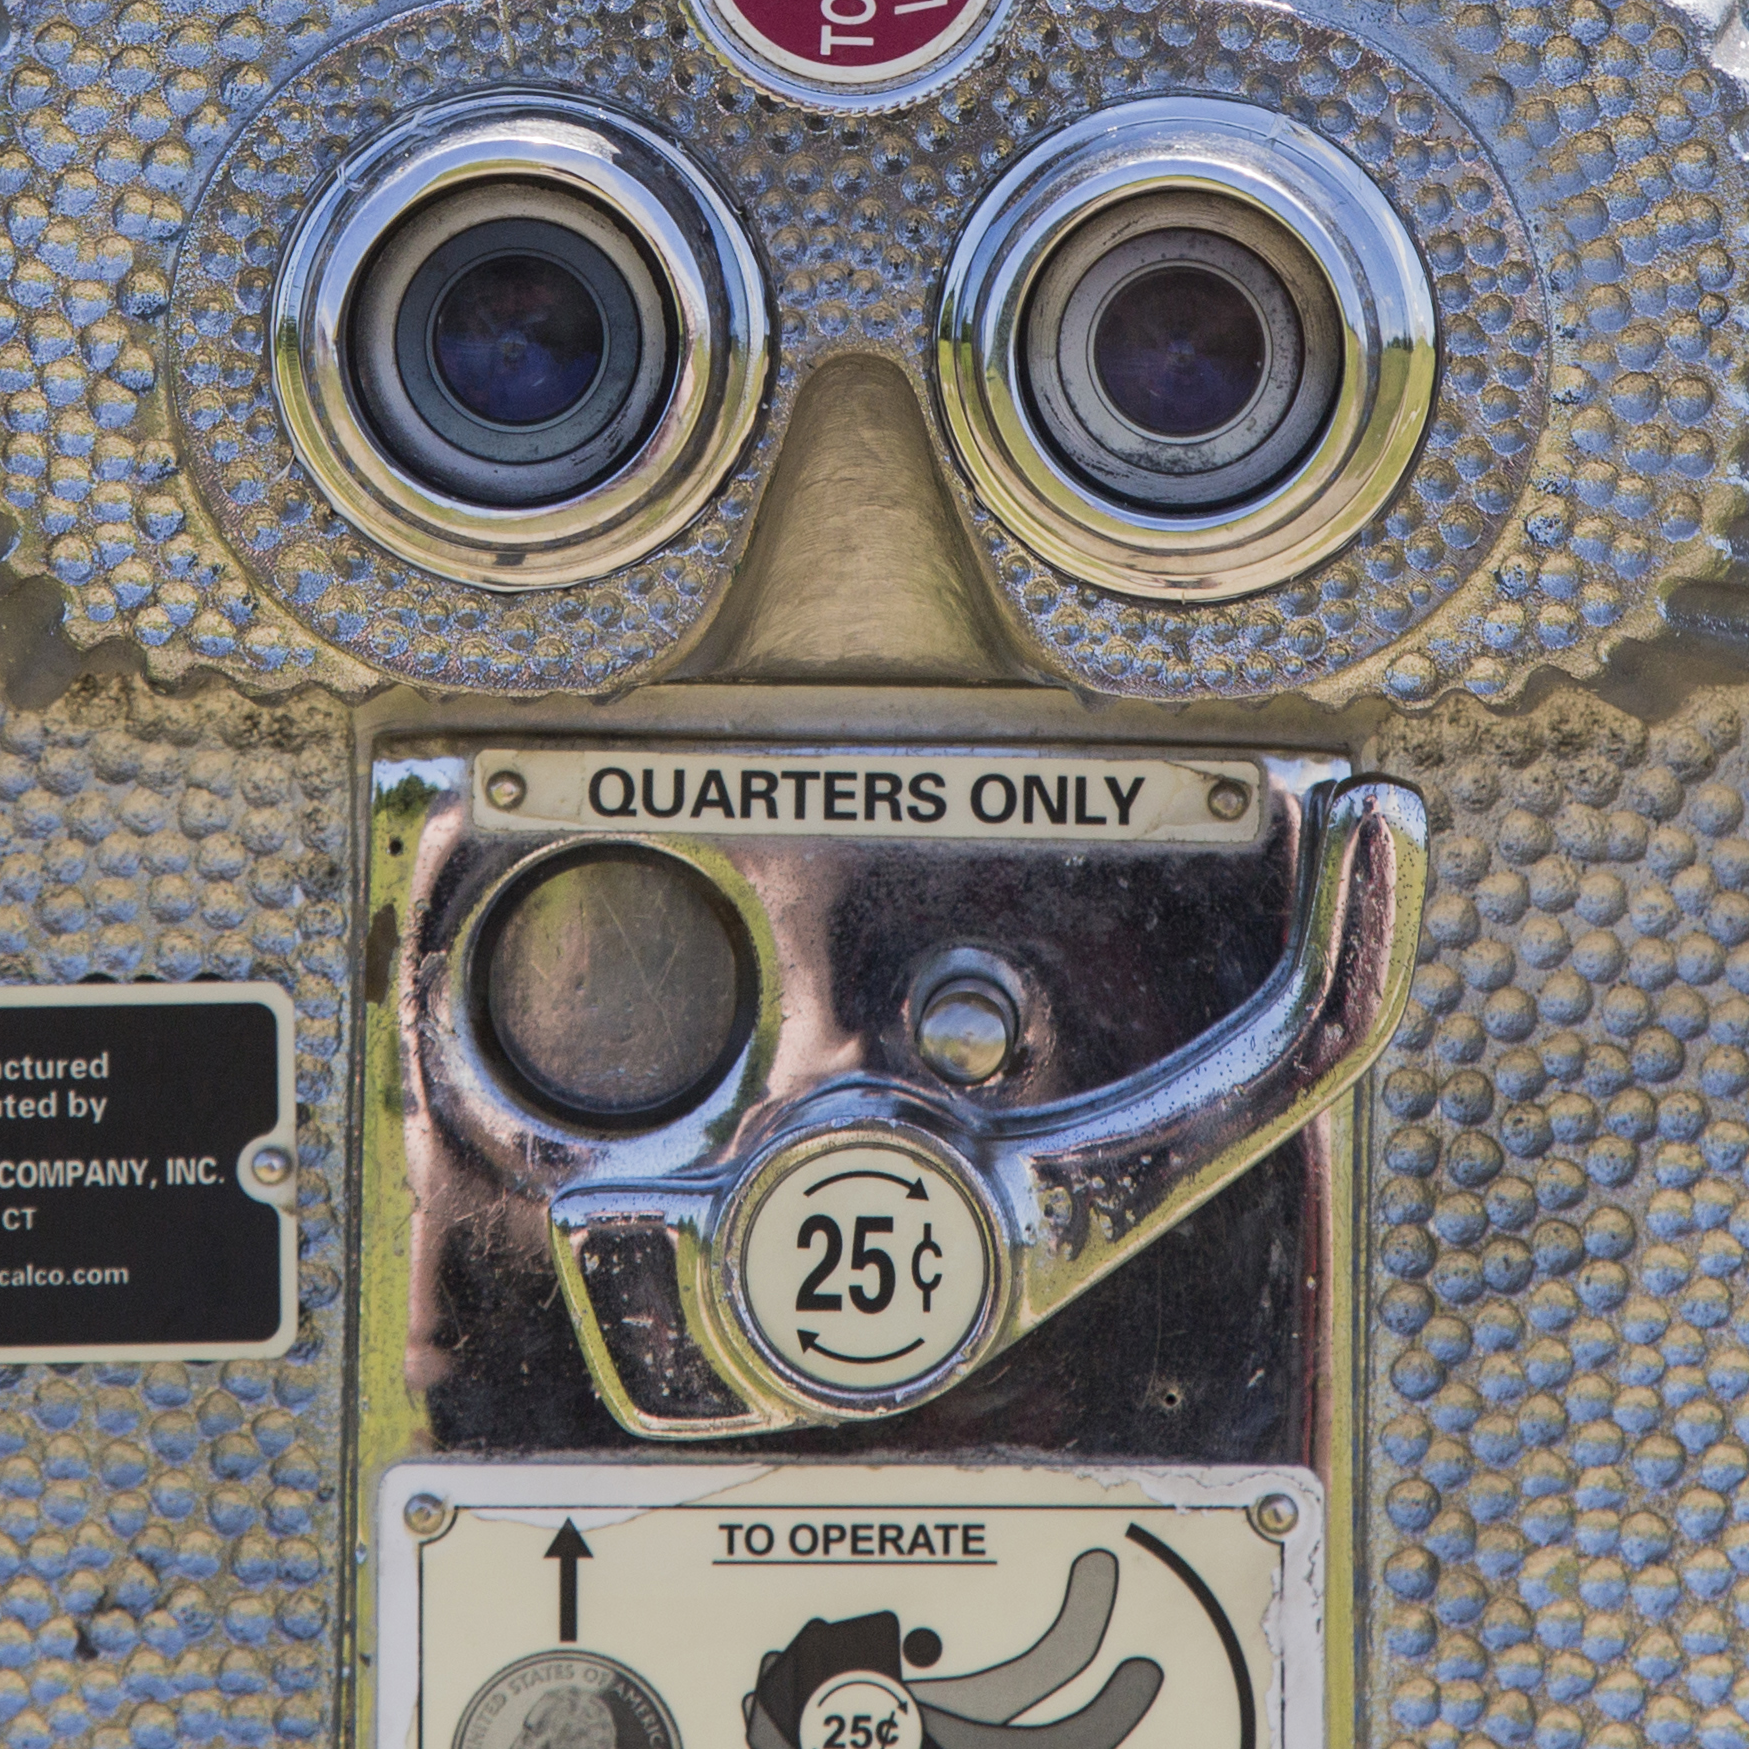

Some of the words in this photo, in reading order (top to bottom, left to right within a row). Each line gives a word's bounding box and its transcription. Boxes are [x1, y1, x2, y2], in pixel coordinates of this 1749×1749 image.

[588, 766, 947, 823] QUARTERS
[970, 773, 1146, 826] ONLY
[67, 1089, 108, 1124] by
[166, 1156, 225, 1185] INC.
[1, 1207, 37, 1231] CT
[795, 1214, 943, 1315] 25¢
[717, 1523, 775, 1556] TO
[788, 1523, 987, 1556] OPERATE
[507, 1662, 576, 1695] STATES
[583, 1666, 613, 1688] OF
[614, 1680, 666, 1749] AMERIC
[822, 1709, 900, 1749] 25¢
